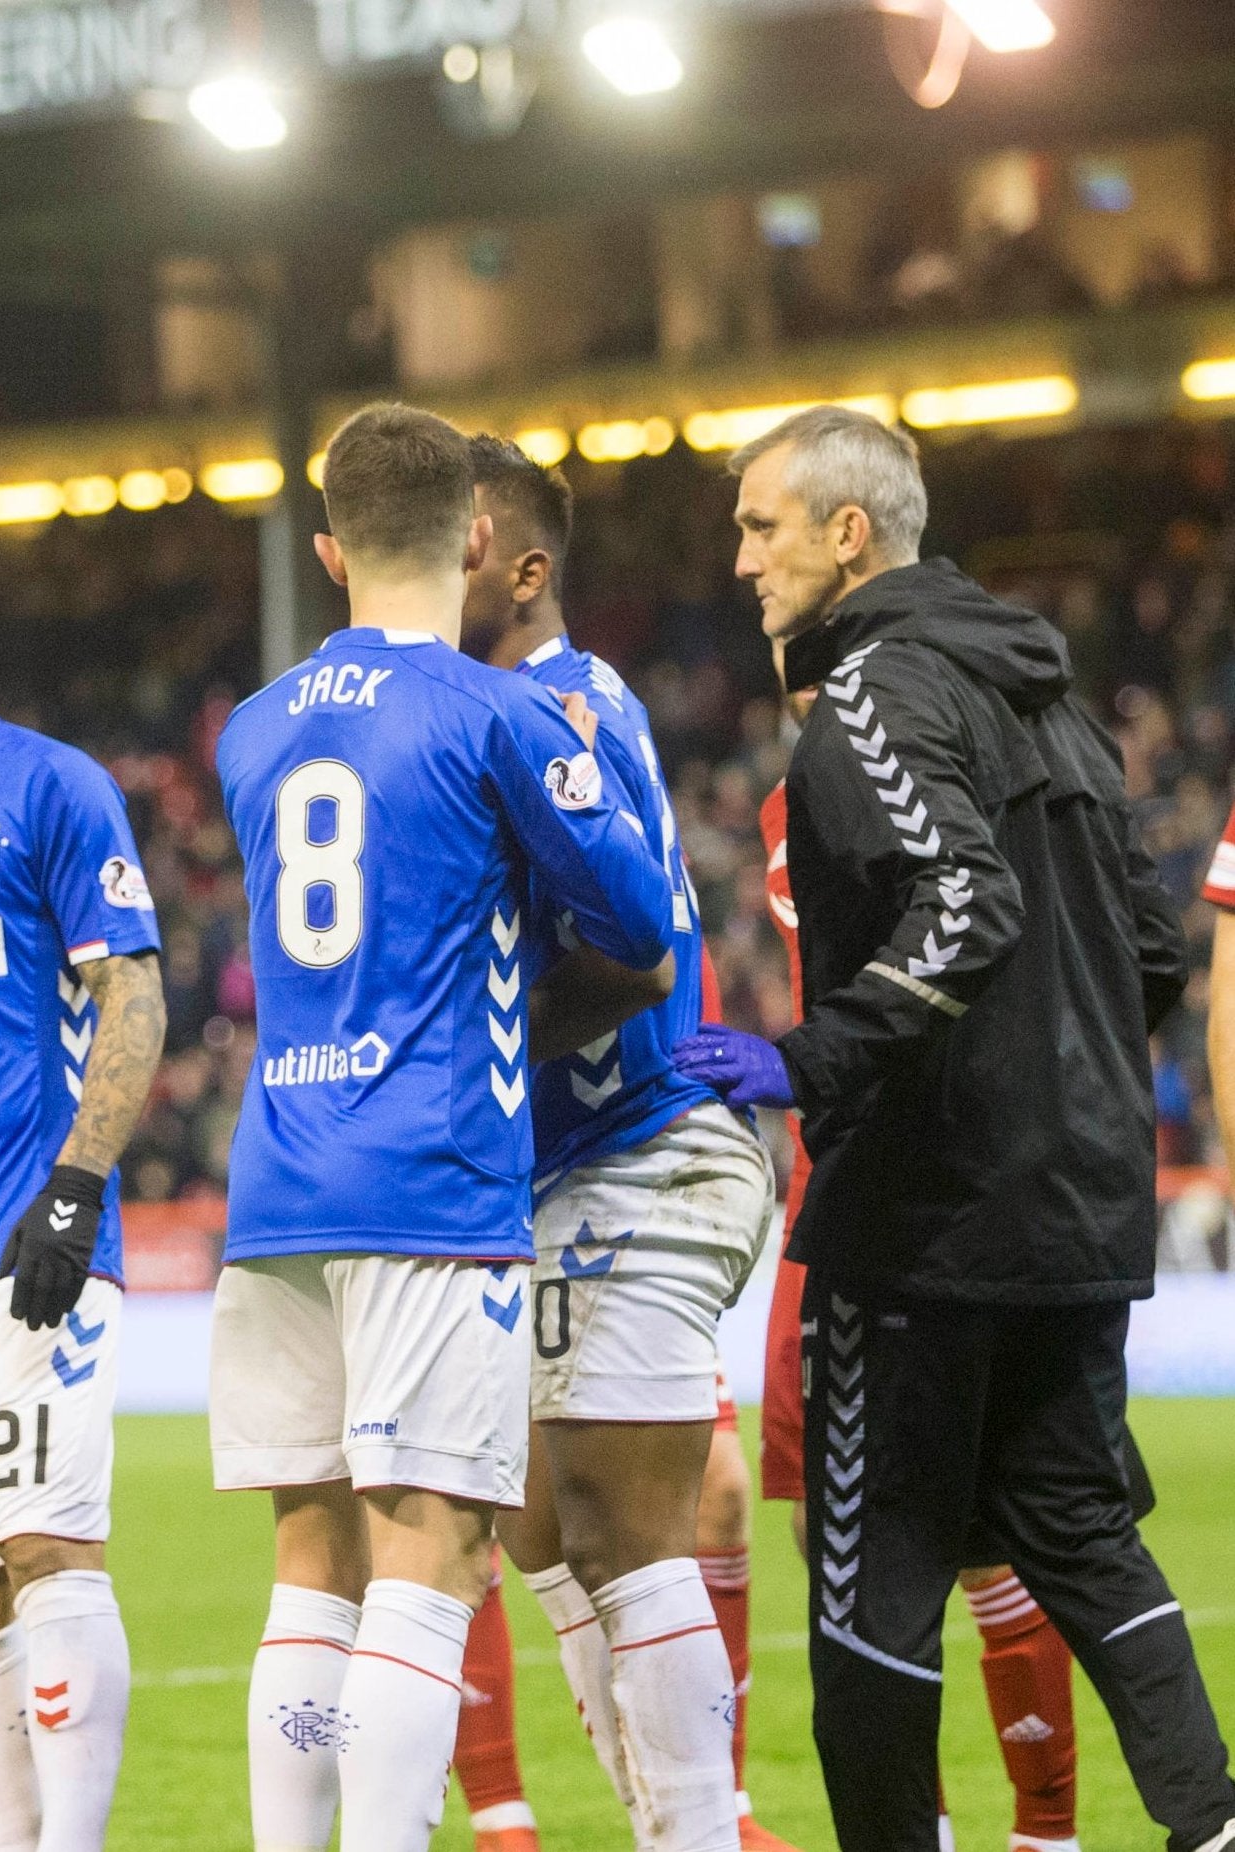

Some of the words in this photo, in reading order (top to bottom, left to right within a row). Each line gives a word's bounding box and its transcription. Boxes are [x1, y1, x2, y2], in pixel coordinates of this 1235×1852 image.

[288, 663, 393, 716] JACK
[276, 757, 365, 970] 8
[263, 1043, 349, 1087] utilita
[348, 1417, 399, 1439] hmmel
